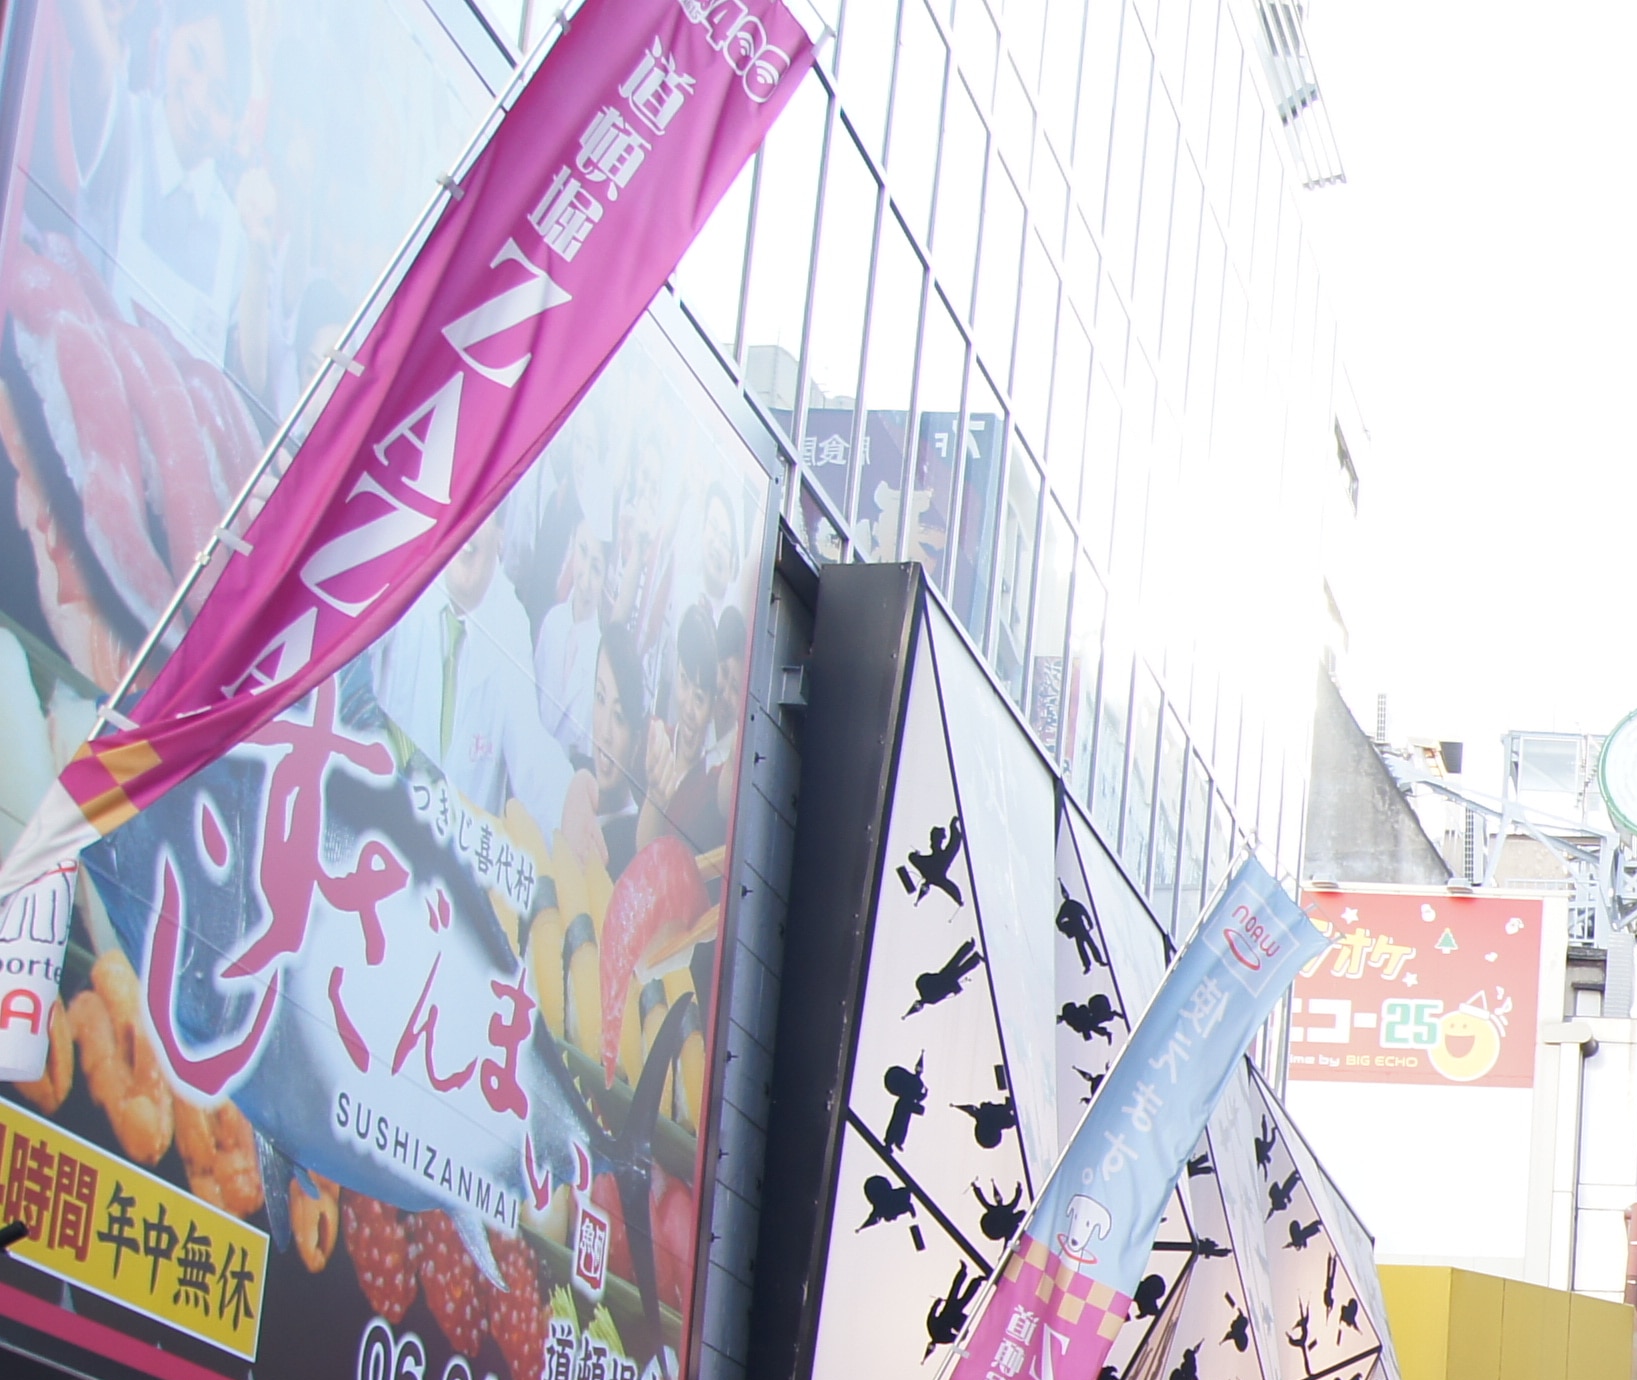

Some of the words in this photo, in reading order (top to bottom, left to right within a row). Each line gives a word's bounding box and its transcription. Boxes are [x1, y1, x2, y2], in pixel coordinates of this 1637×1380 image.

[527, 35, 697, 262] 道頓堀
[411, 784, 536, 910] つきじ喜代村
[1318, 1054, 1340, 1067] by
[1346, 1055, 1370, 1066] BIG
[1374, 1055, 1418, 1068] ECHO
[1380, 998, 1444, 1049] 25
[0, 1115, 98, 1264] 時間
[96, 1180, 258, 1334] 年中無休
[335, 1091, 519, 1229] SUSHIZANMAI
